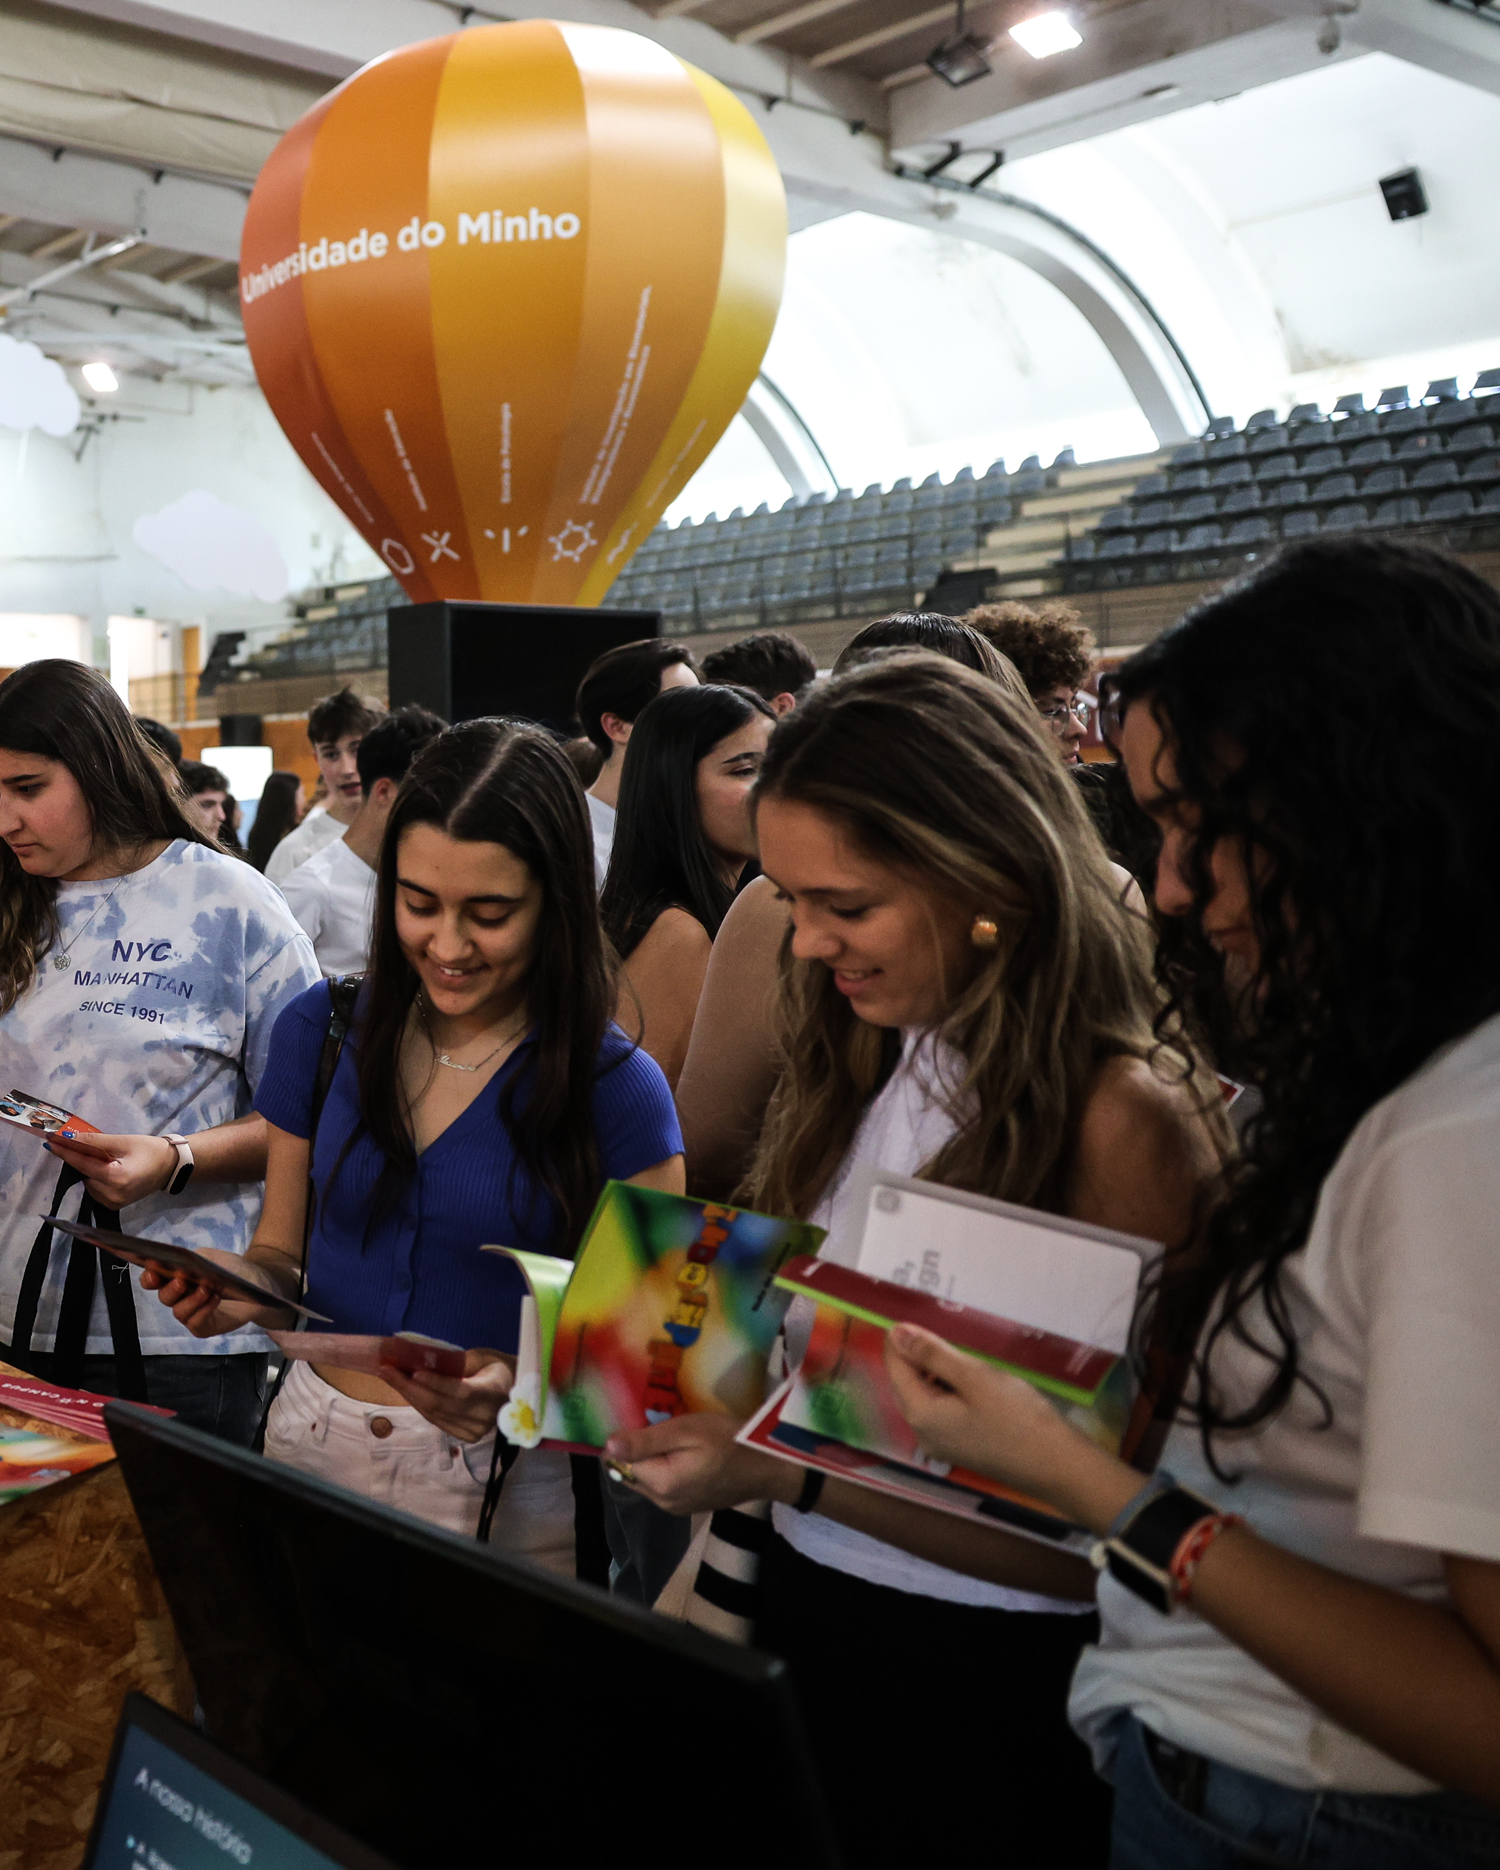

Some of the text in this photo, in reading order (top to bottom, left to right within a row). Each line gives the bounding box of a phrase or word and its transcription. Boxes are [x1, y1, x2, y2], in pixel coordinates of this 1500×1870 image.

[240, 207, 581, 304] Universidade do Minho
[111, 940, 172, 963] NYC
[73, 970, 194, 1000] MANHATTAN
[78, 1001, 166, 1026] SINCE 1991
